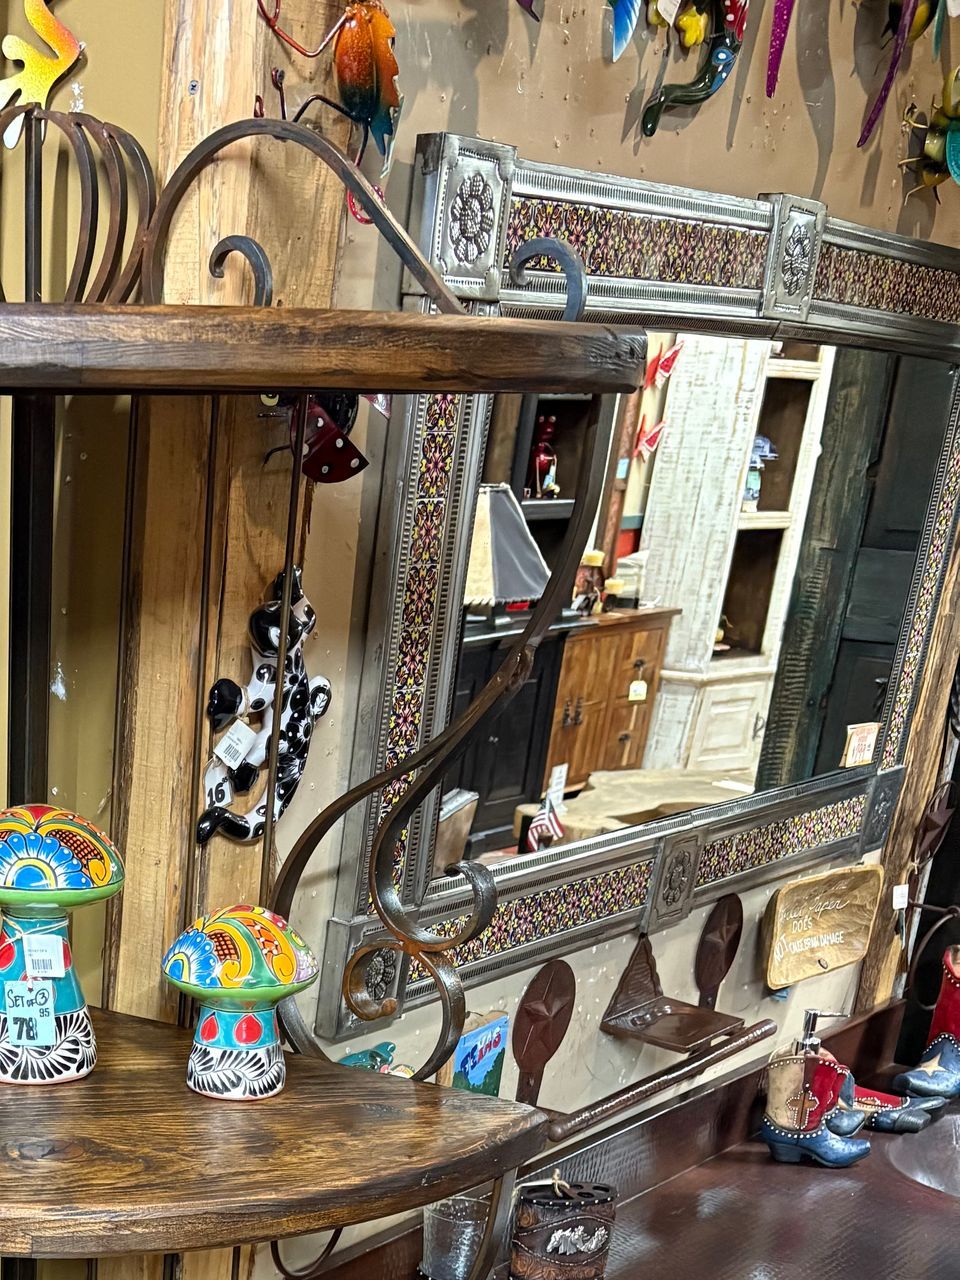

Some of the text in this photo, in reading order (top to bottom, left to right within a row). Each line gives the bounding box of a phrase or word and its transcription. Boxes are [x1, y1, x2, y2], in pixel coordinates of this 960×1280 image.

[207, 782, 225, 808] 16
[792, 915, 813, 934] DOES
[39, 1007, 50, 1017] 95
[13, 1016, 38, 1040] 78
